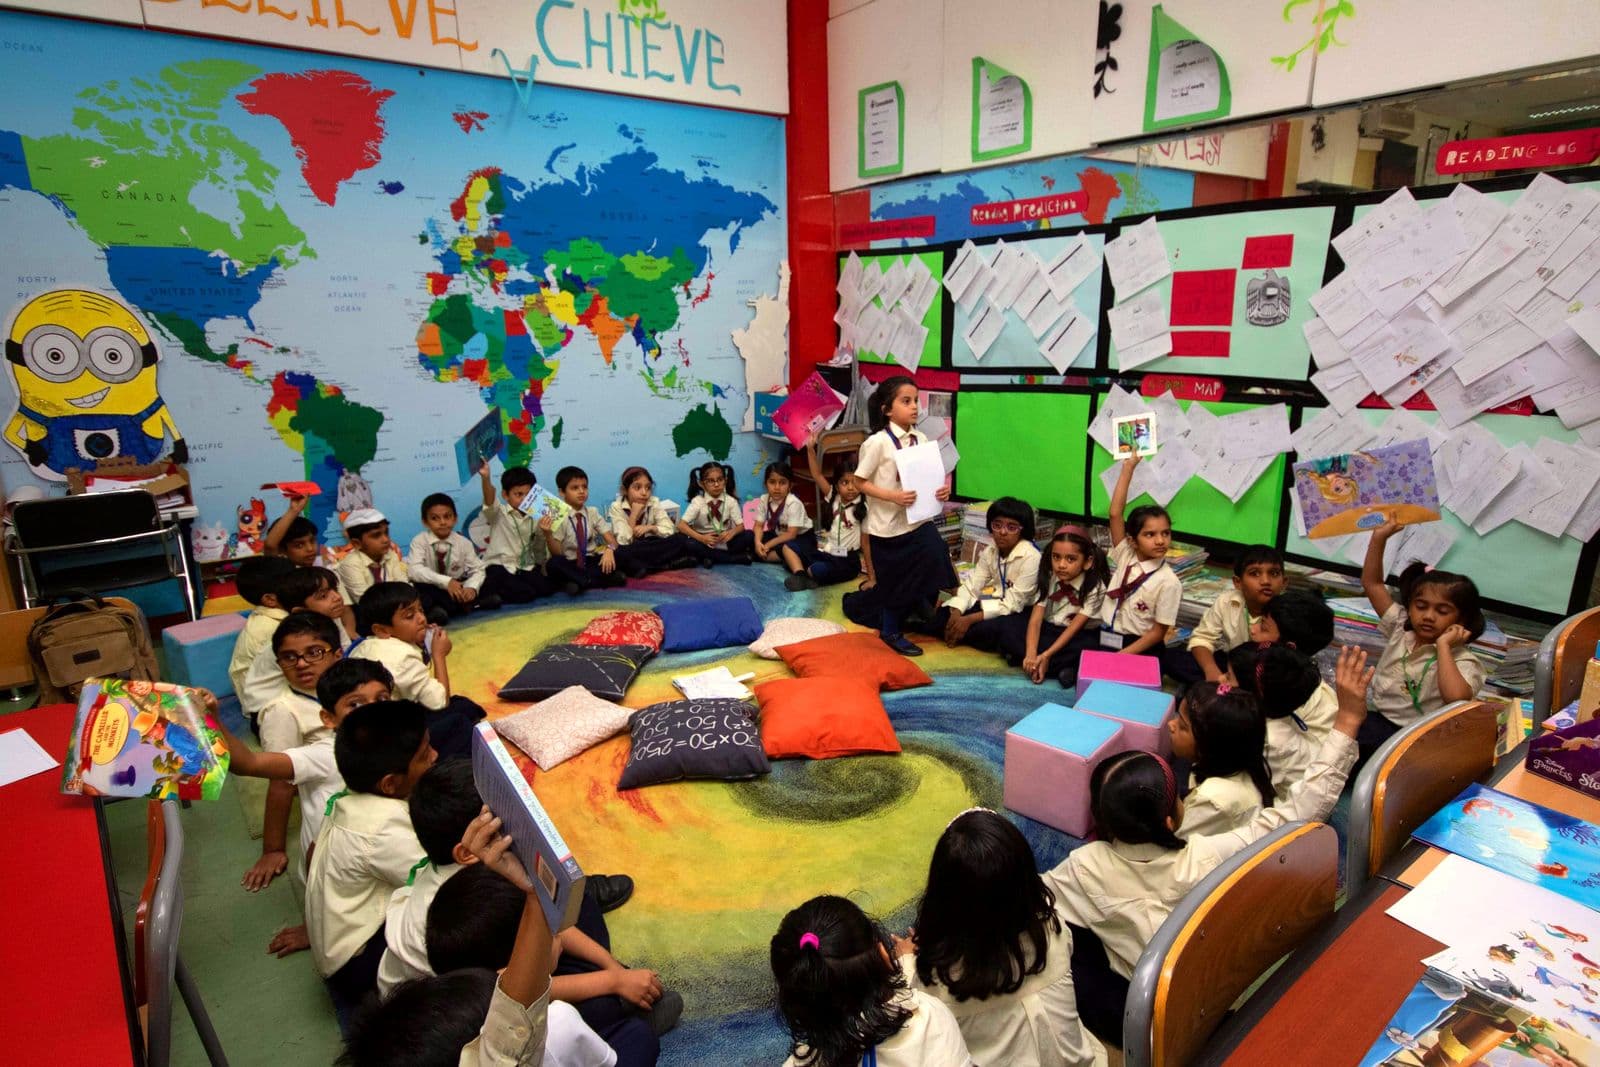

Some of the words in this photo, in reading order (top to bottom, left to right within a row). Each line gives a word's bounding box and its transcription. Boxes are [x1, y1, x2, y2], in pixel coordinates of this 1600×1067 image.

[1445, 145, 1538, 166] READING
[1548, 142, 1577, 155] LOG
[101, 190, 176, 202] CANADA
[17, 275, 56, 283] NORTH
[1194, 381, 1221, 397] MAP
